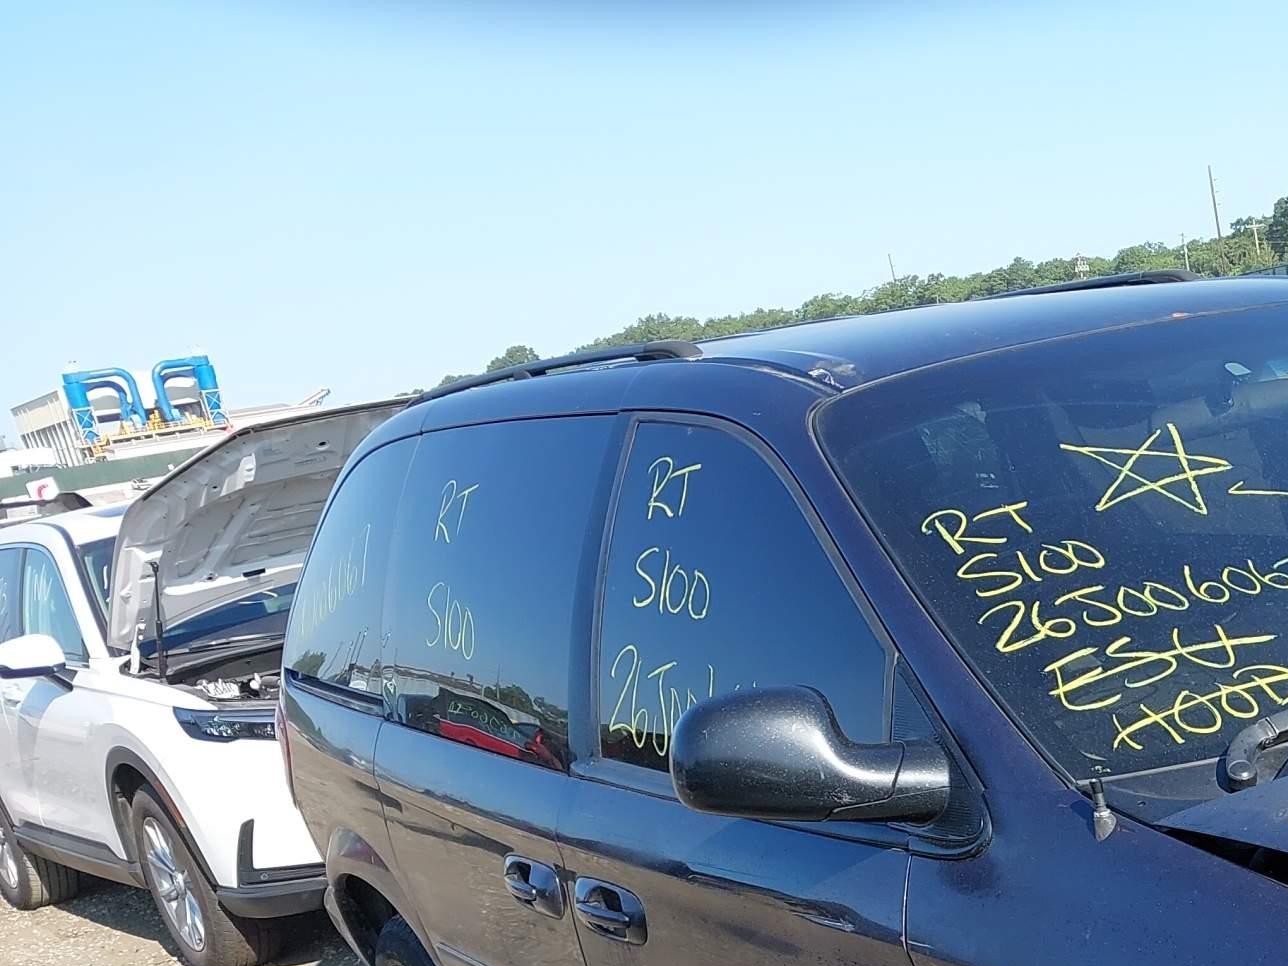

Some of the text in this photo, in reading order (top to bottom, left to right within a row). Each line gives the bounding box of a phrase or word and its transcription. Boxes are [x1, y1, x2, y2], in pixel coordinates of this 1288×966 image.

[433, 479, 480, 544] RT
[647, 456, 703, 521] RT
[921, 500, 1033, 555] RT
[631, 546, 711, 620] S100
[957, 540, 1105, 598] S100
[425, 581, 476, 661] S100
